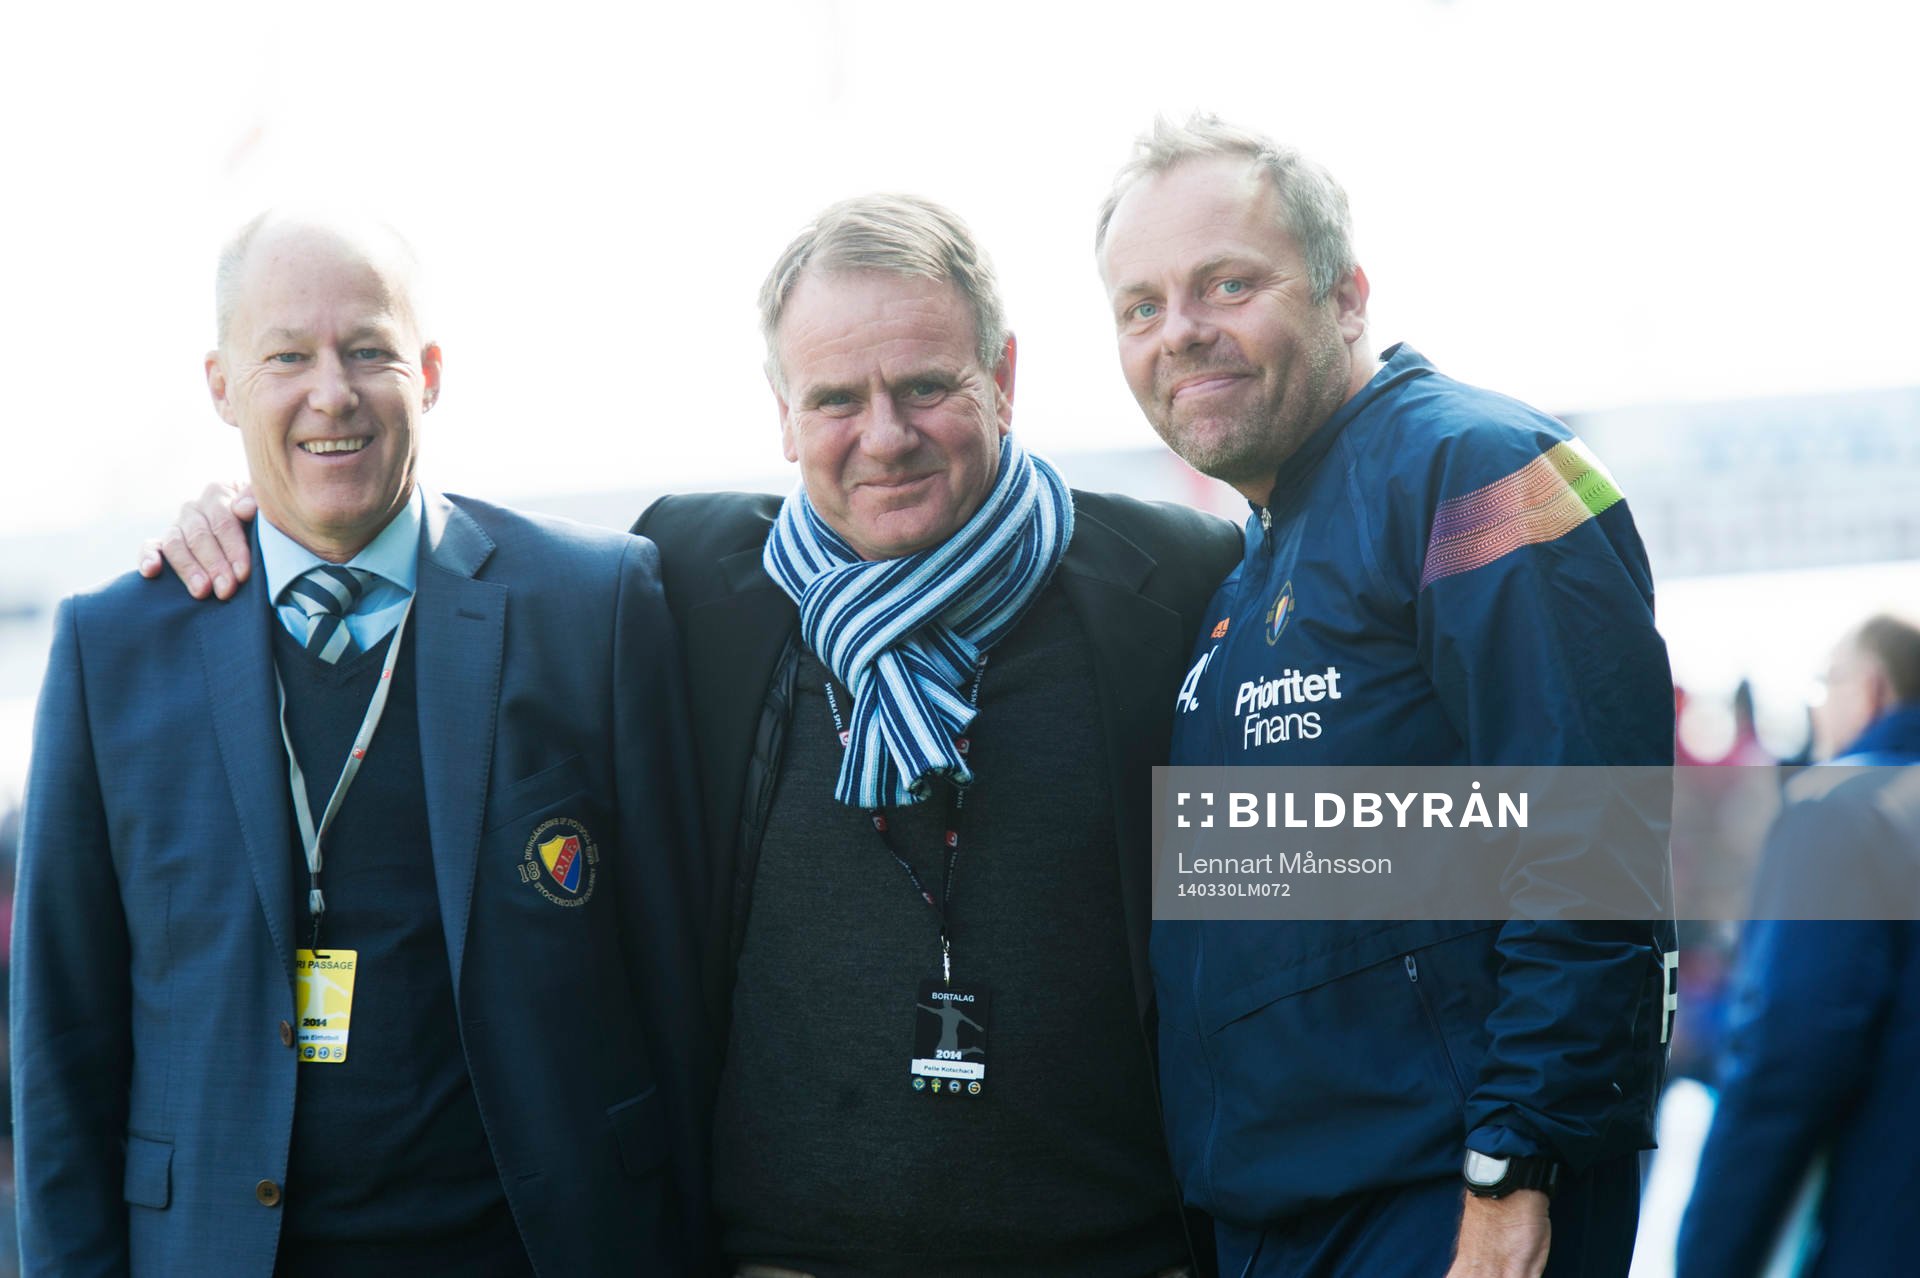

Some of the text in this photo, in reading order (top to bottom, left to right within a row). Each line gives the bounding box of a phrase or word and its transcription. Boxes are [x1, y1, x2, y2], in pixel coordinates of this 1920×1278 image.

[1234, 666, 1342, 717] Prioritet
[833, 714, 843, 730] SPEL
[1244, 712, 1322, 750] Finans
[517, 860, 541, 883] 18
[308, 960, 353, 970] PASSAGE
[931, 992, 975, 1002] BORTALAG
[303, 1018, 327, 1027] 2014
[935, 1049, 962, 1060] 2014
